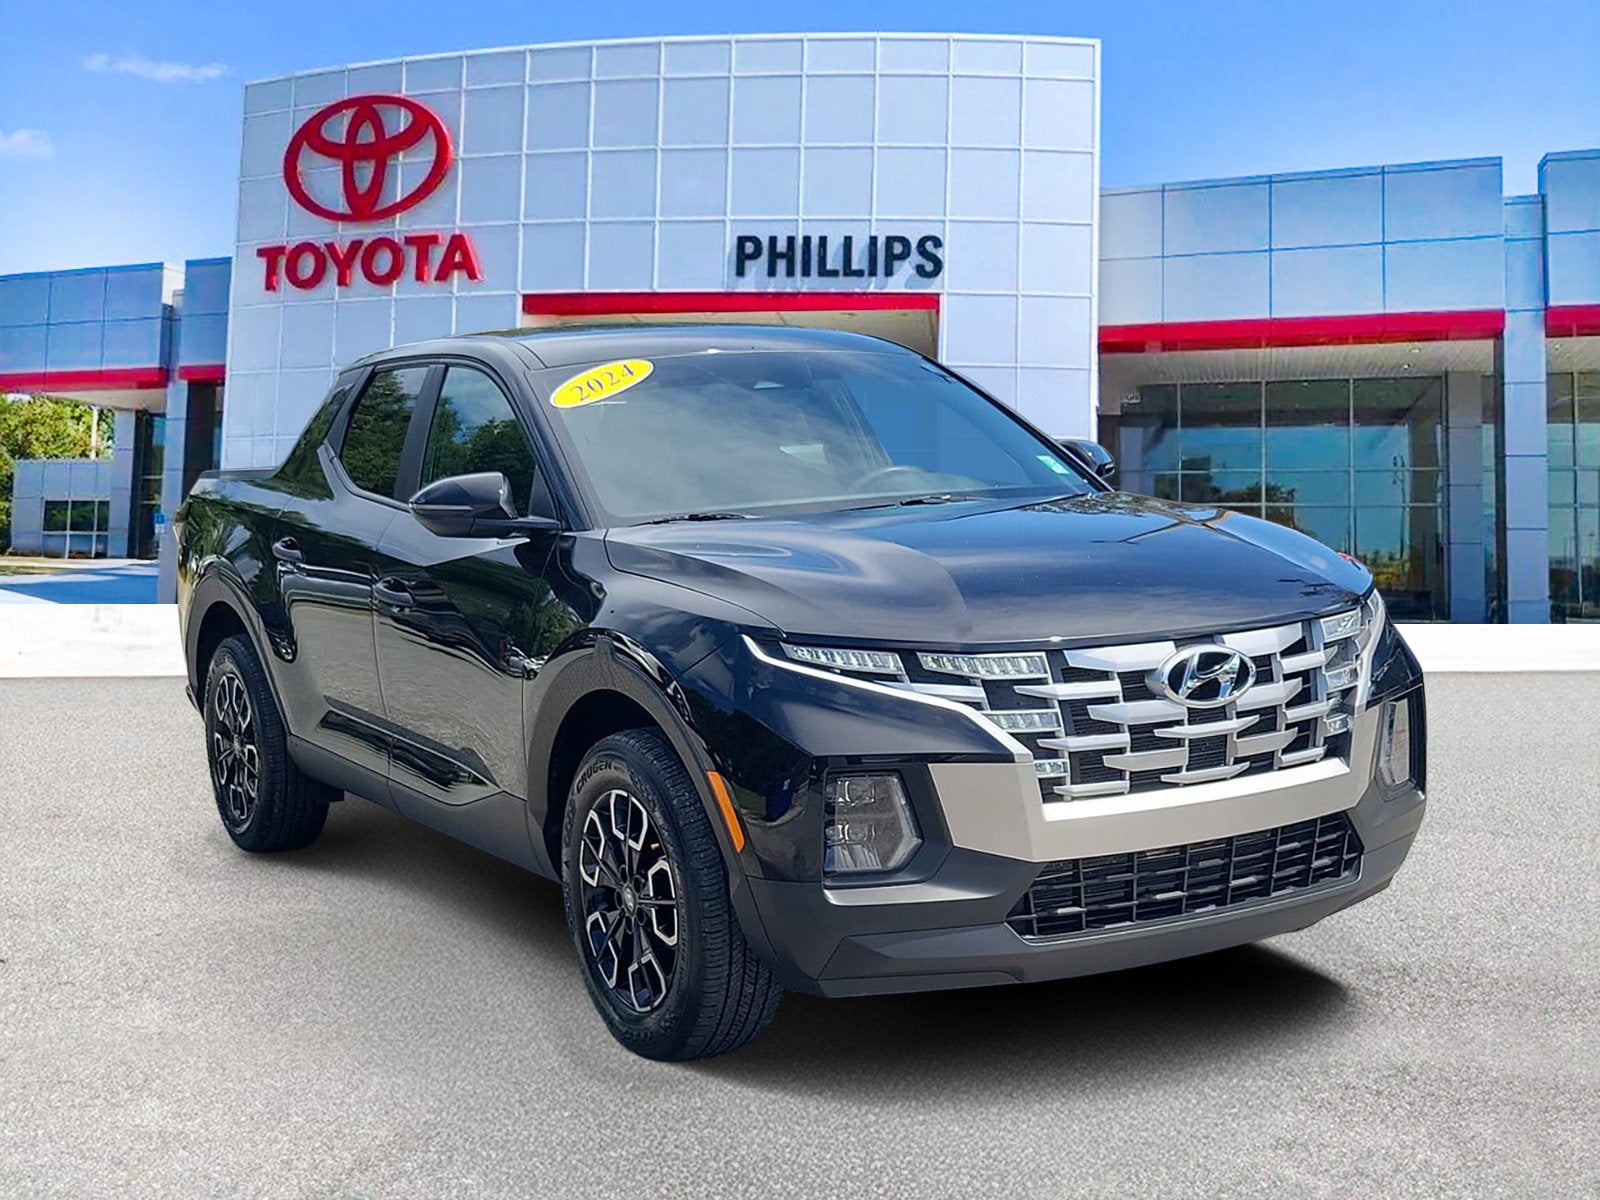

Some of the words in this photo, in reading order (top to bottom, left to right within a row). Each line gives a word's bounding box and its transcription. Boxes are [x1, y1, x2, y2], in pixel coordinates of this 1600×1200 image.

[256, 234, 482, 291] TOYOTA
[736, 235, 943, 278] PHILLIPS
[570, 364, 635, 401] 2024
[576, 760, 612, 794] CRUGEN
